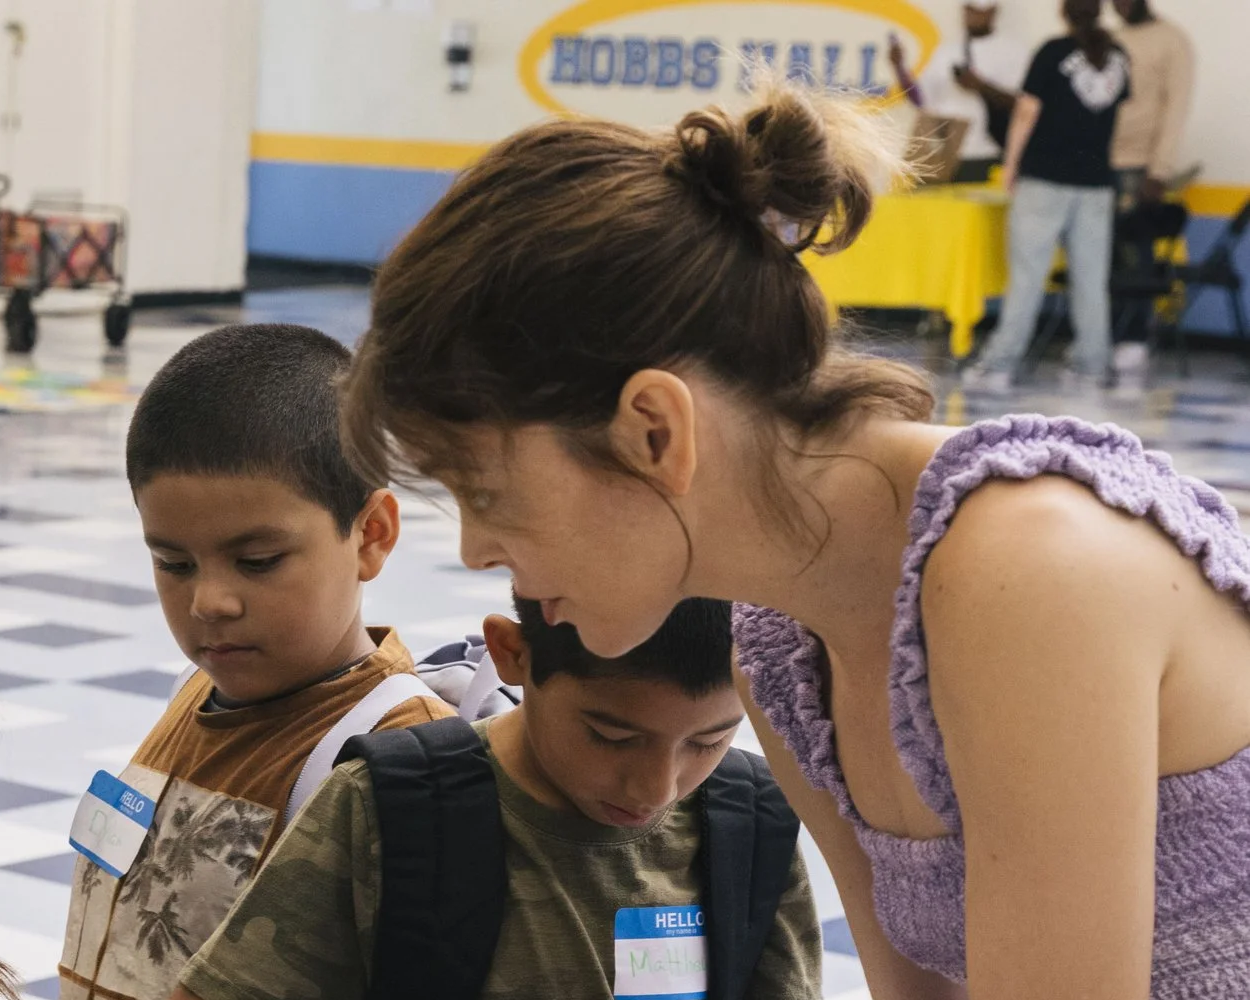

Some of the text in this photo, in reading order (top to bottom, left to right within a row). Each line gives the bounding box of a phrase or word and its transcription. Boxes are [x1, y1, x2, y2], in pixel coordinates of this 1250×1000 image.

[551, 36, 720, 89] HOBBS
[120, 791, 145, 813] HELLO
[656, 912, 704, 928] HELLO
